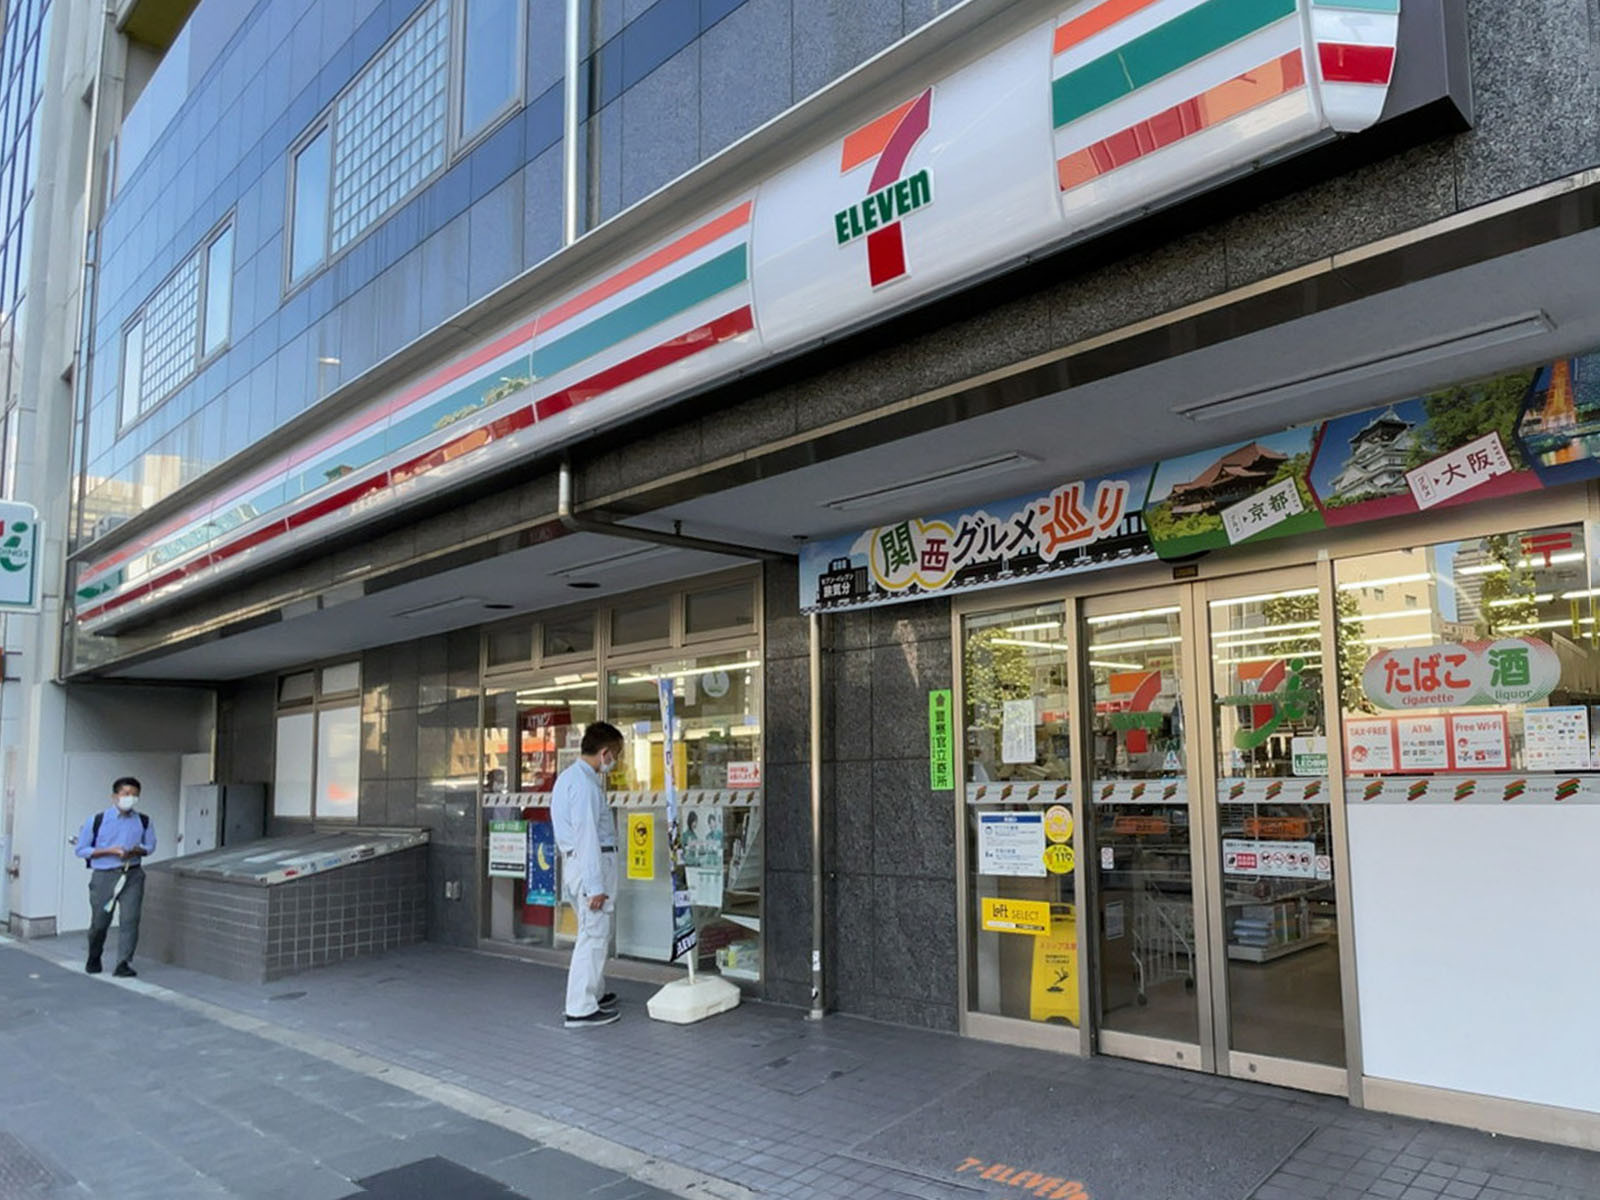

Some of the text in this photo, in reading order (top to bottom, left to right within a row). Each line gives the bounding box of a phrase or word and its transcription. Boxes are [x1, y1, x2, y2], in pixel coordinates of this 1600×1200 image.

[1441, 449, 1494, 486] 大阪
[1248, 490, 1288, 523] 京都
[880, 485, 1124, 578] 関西グルメ巡り
[1384, 647, 1530, 695] たばこ 酒
[1402, 688, 1533, 706] cigarette liquor
[1350, 726, 1387, 736] TAX-FREE
[1411, 724, 1432, 734] ATM
[1456, 722, 1475, 732] Free
